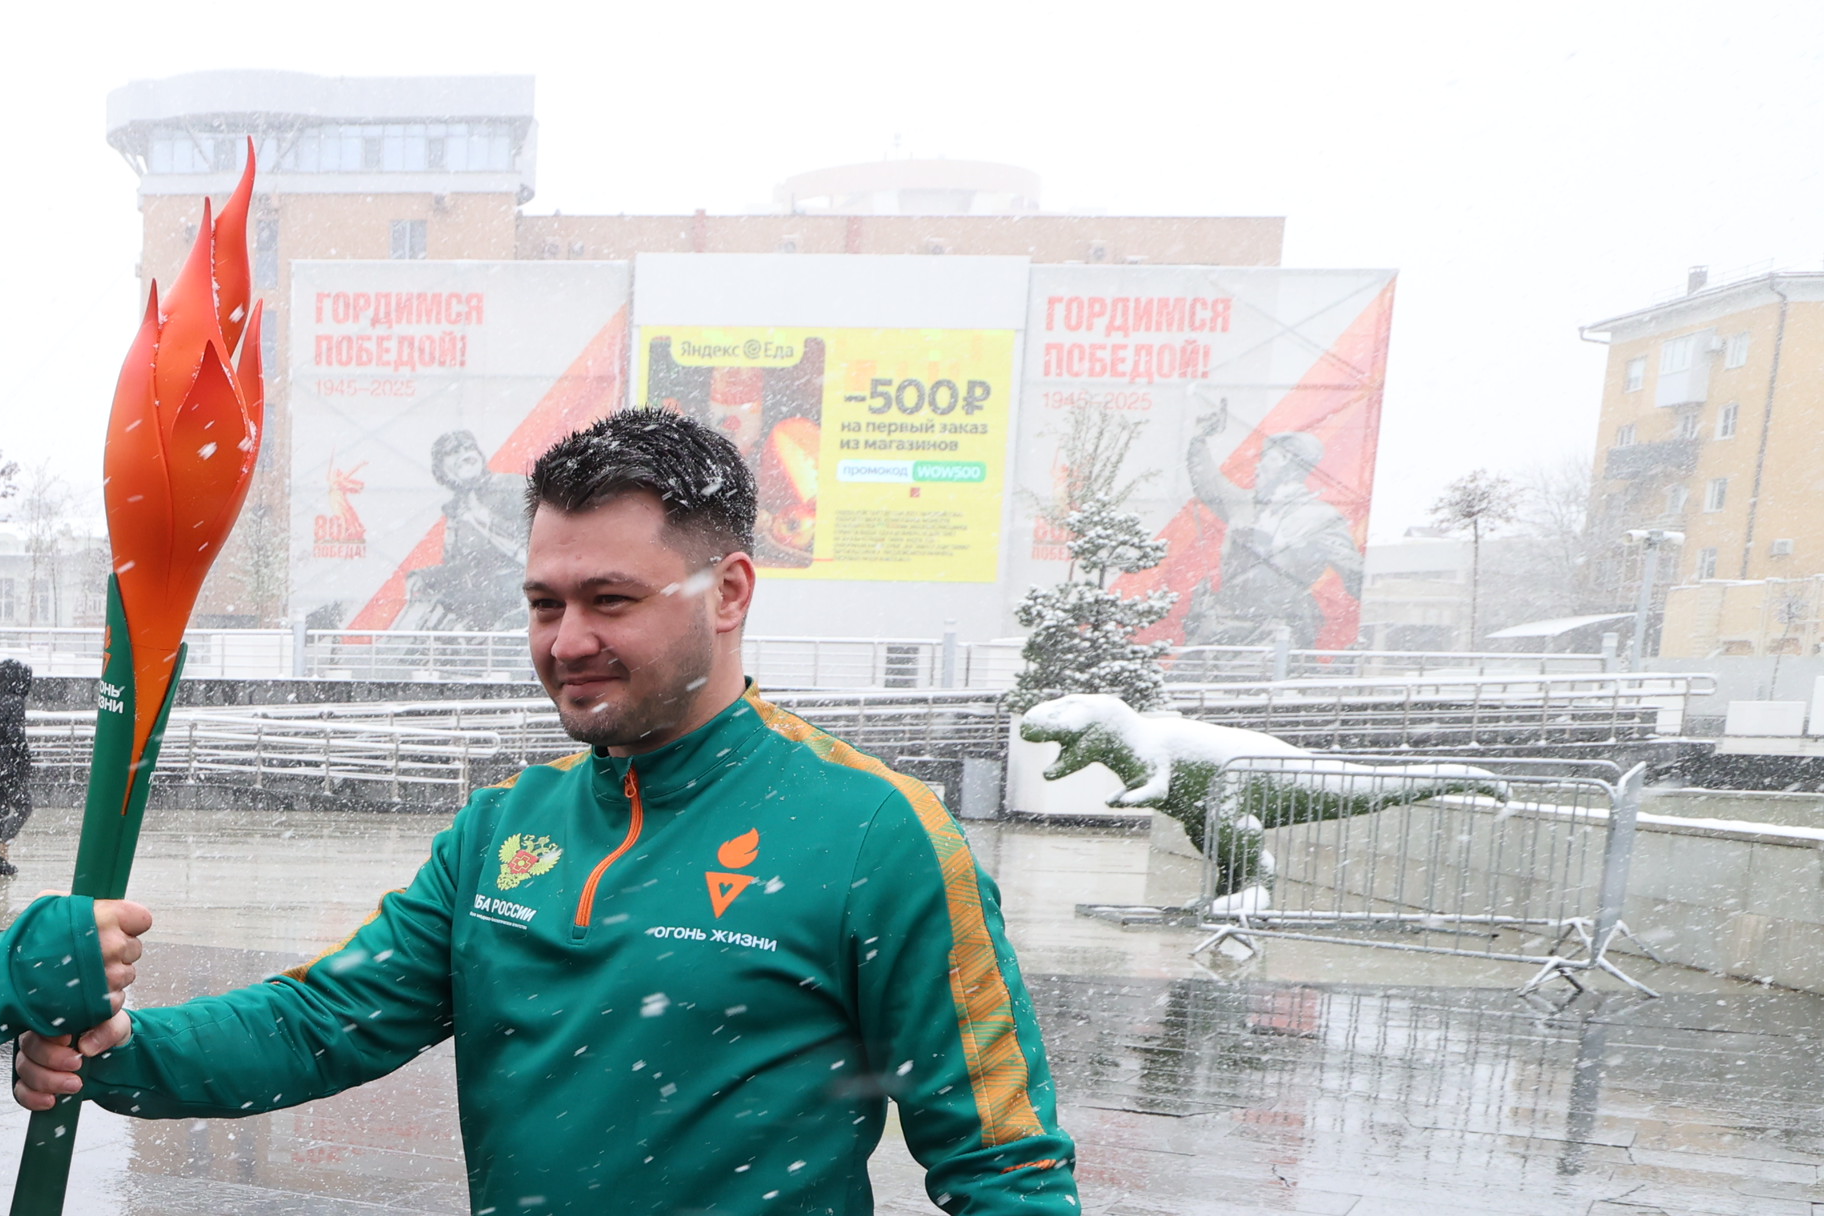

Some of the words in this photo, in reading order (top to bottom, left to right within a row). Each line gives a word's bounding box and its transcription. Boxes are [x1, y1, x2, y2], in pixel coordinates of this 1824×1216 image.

[315, 291, 484, 329] ГОРДИМСЯ
[1045, 296, 1232, 337] ГОРДИМСЯ
[314, 331, 468, 372] ПОБЕДОЙ!
[681, 340, 739, 358] Яндекс
[764, 342, 794, 358] Еда
[1043, 340, 1211, 384] ПОБЕДОЙ!
[841, 422, 861, 433] на
[866, 419, 935, 435] первый
[939, 424, 988, 434] заказ
[840, 439, 859, 450] из
[864, 440, 959, 451] магазинов
[843, 464, 908, 477] промокод
[917, 466, 982, 480] WOW500
[474, 893, 491, 912] БА
[491, 898, 537, 922] РОССИИ
[654, 926, 707, 941] ОГОНЬ
[709, 928, 778, 952] ЖИЗНИ
